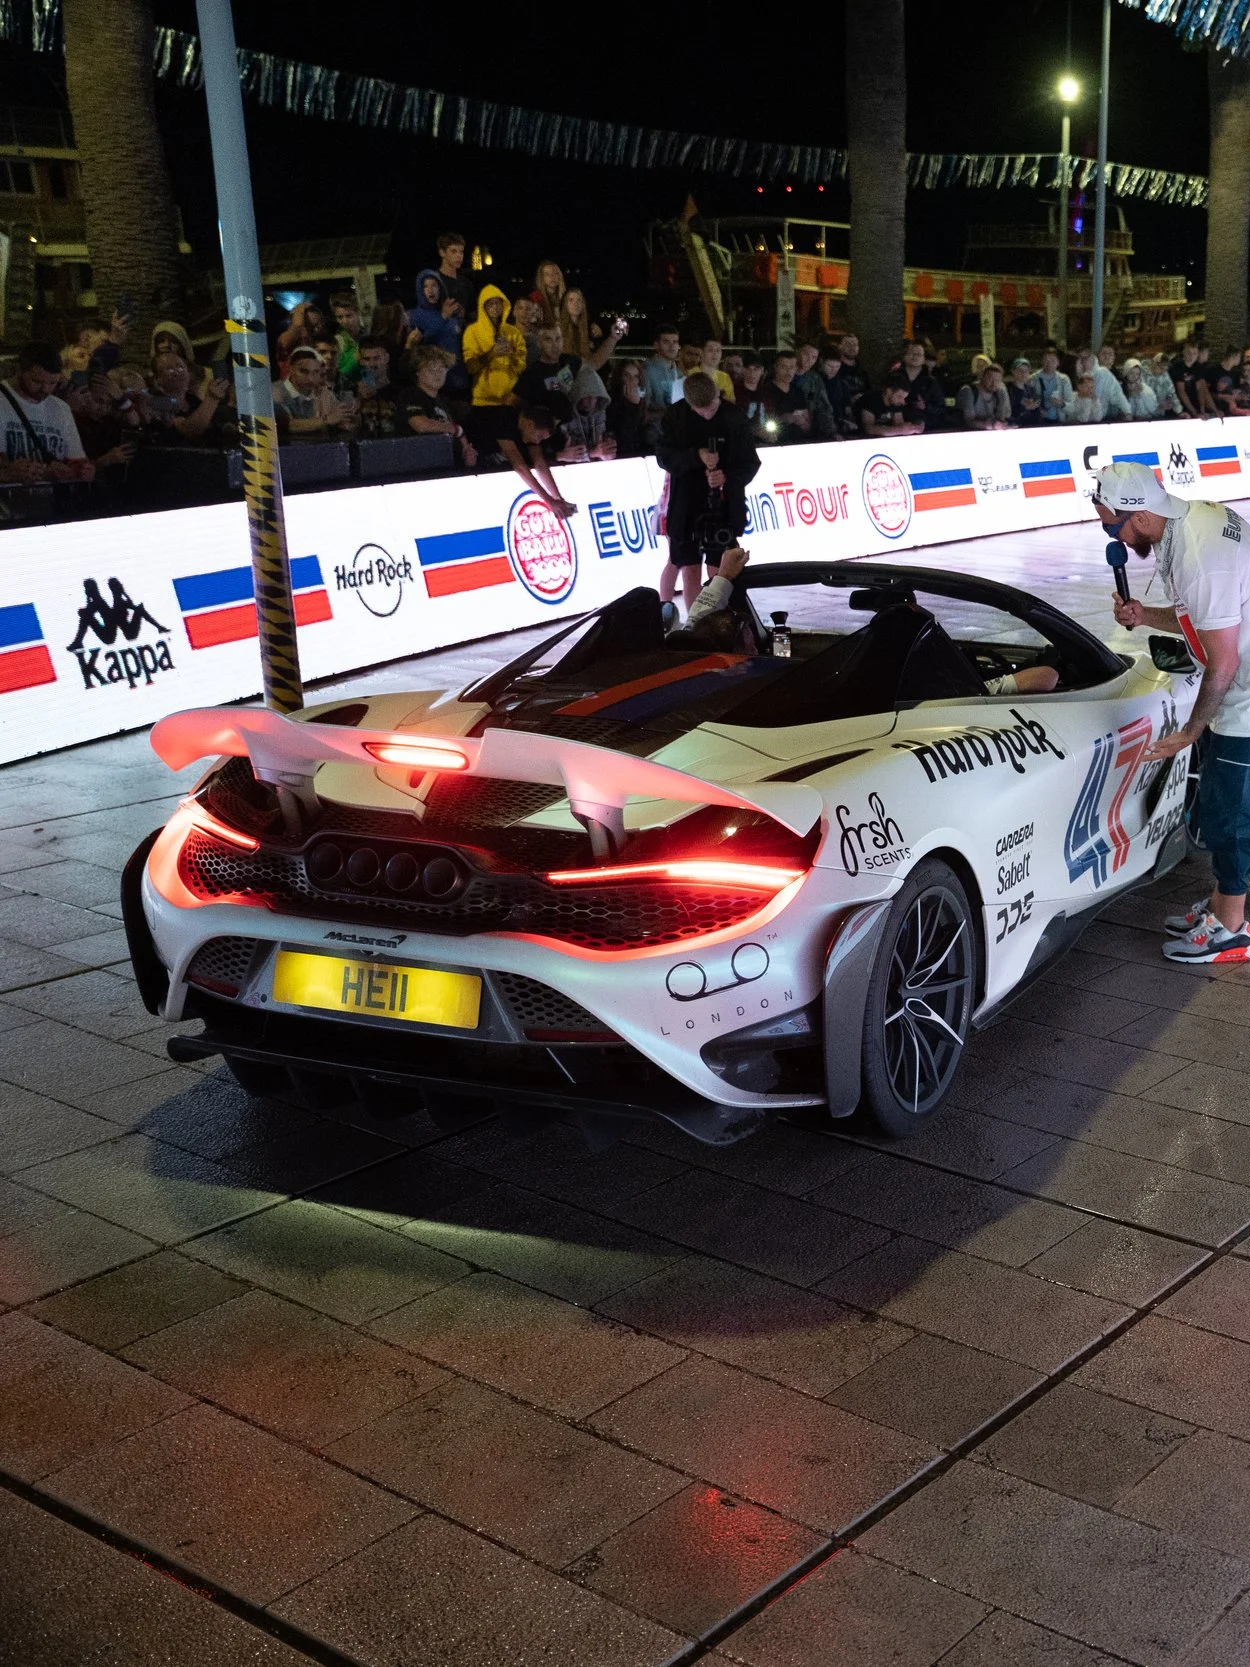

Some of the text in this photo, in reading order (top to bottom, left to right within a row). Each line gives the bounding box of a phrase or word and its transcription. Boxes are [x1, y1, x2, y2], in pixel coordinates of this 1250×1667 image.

[772, 481, 849, 525] Tour
[518, 534, 568, 562] BALL
[334, 555, 414, 590] Hard Rock
[76, 640, 176, 691] Kappa
[891, 709, 1066, 784] Hard Rock
[1064, 715, 1152, 889] 47
[836, 792, 904, 877] frsh
[995, 821, 1034, 857] CARRERA
[864, 847, 913, 869] SCENTS
[997, 852, 1031, 895] Sabelt
[323, 931, 397, 949] McLaren
[660, 990, 793, 1036] LONDON
